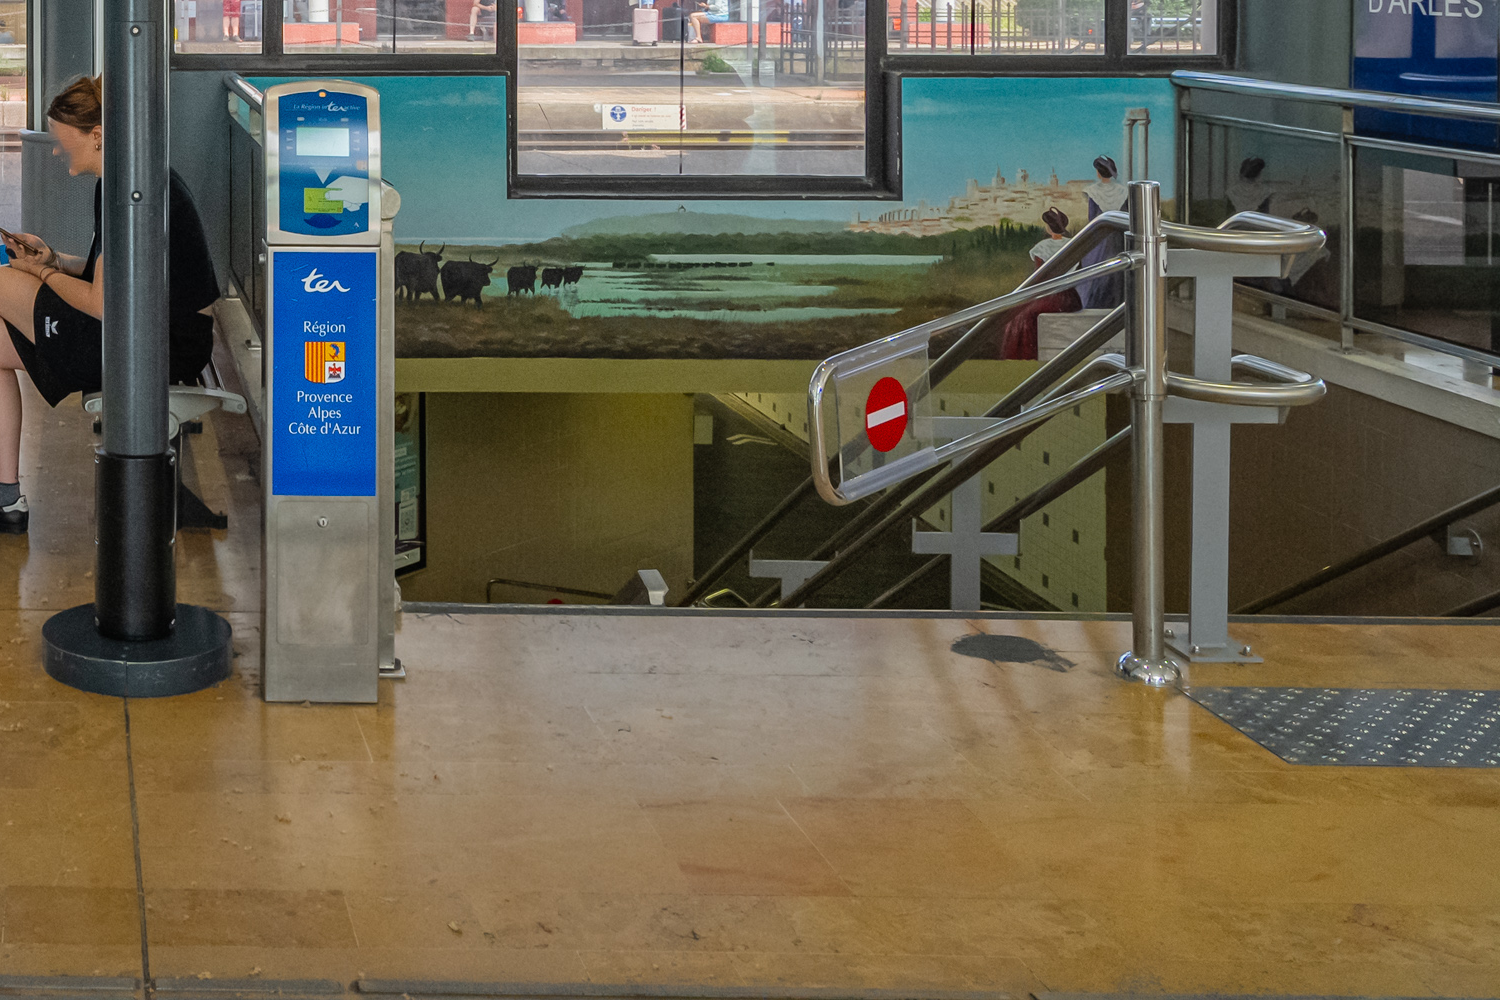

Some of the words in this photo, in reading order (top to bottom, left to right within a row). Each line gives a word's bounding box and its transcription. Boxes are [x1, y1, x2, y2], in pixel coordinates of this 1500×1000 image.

[301, 267, 350, 293] ter
[303, 320, 346, 336] Région
[296, 391, 353, 402] Provence
[308, 406, 342, 421] Alpes
[288, 421, 317, 435] Côte
[320, 421, 361, 435] d'Azur
